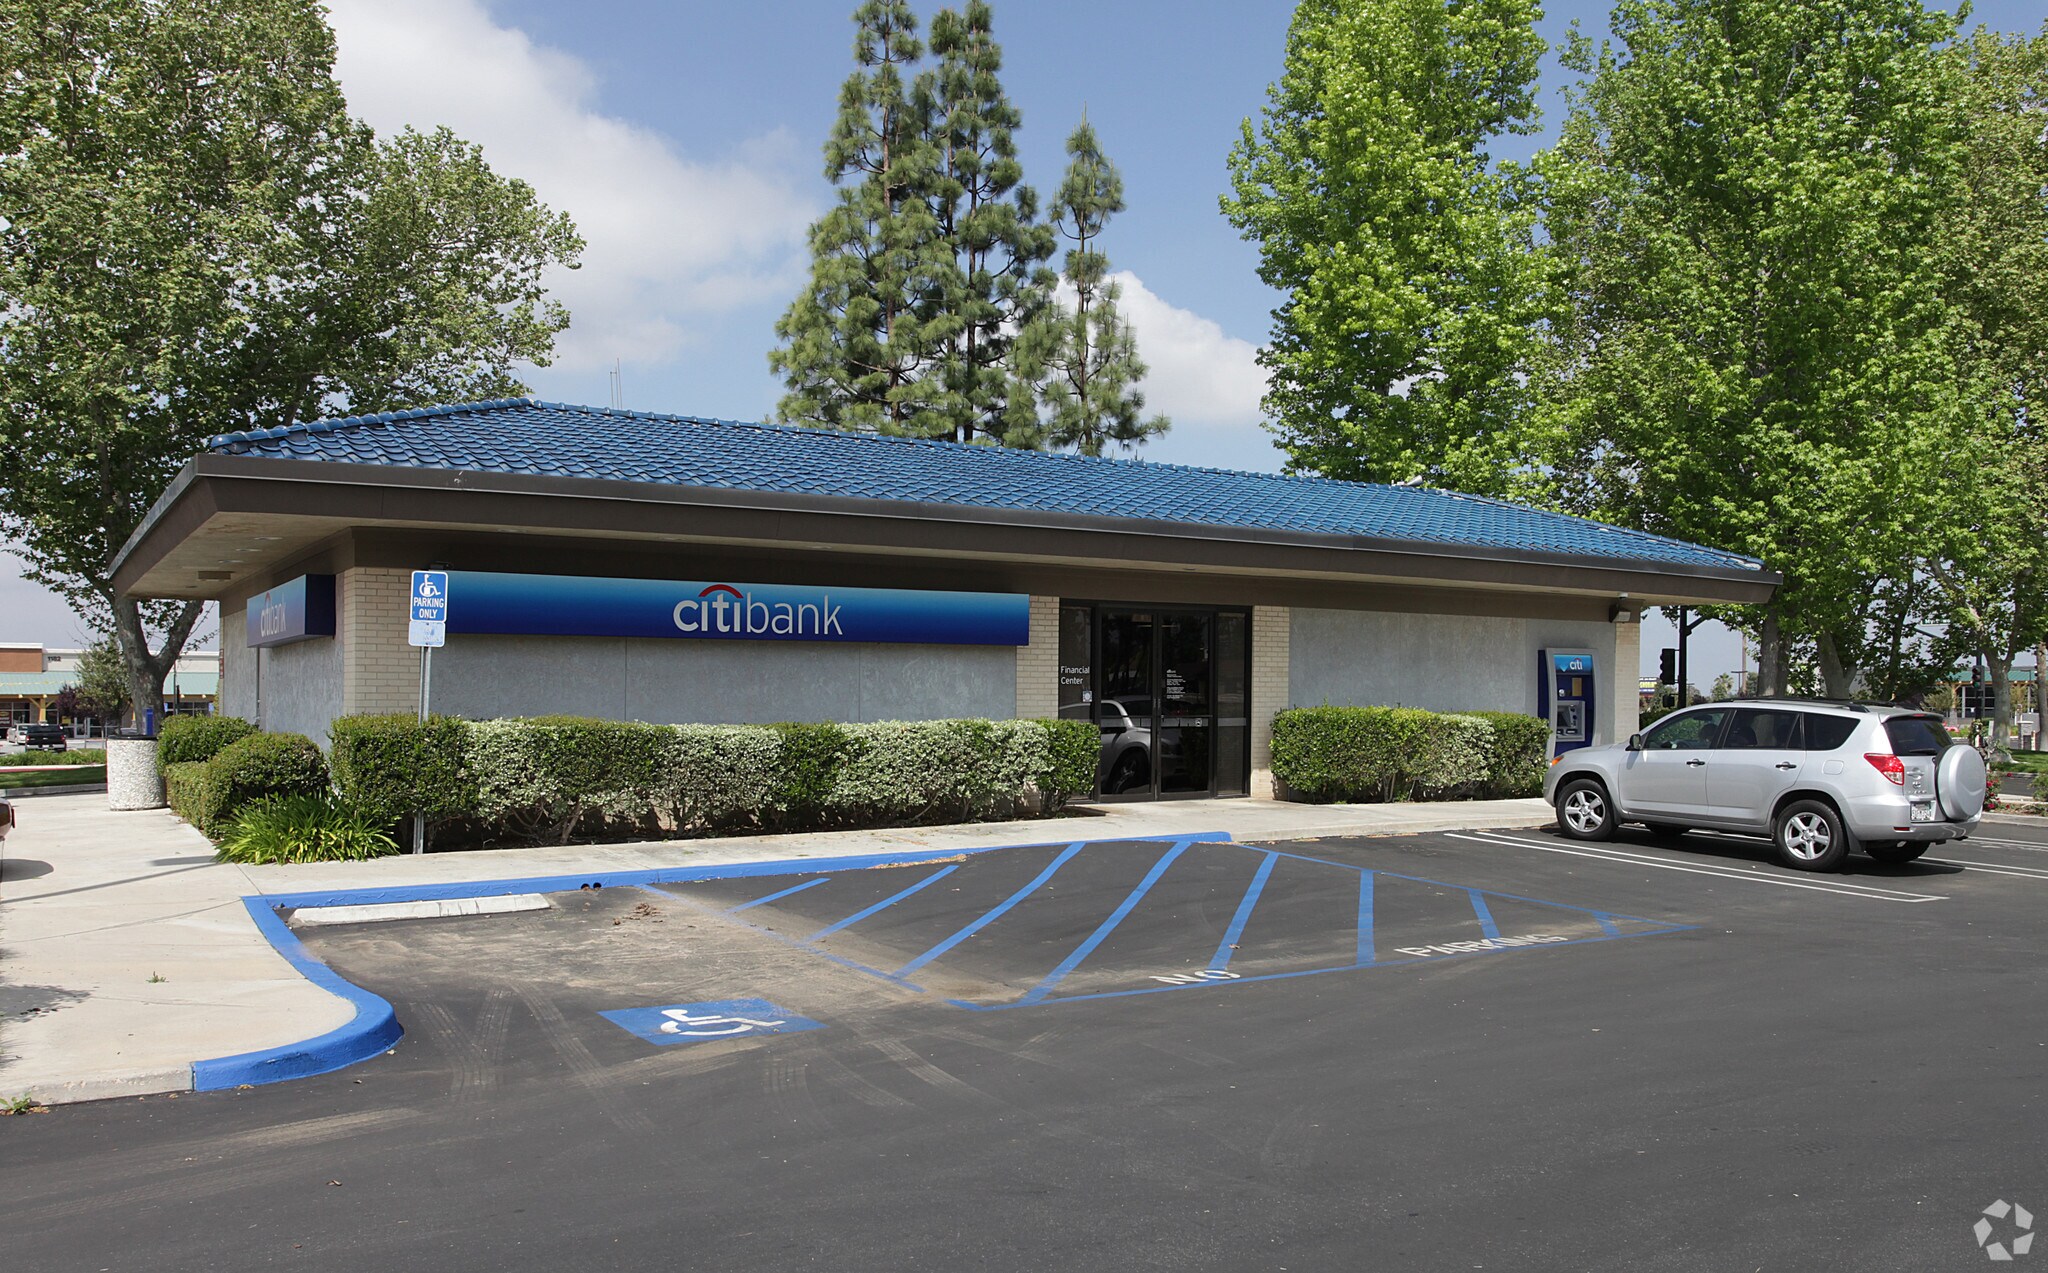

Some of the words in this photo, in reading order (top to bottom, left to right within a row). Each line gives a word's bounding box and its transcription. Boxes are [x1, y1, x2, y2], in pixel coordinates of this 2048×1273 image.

[413, 597, 444, 608] PARKING
[419, 608, 438, 619] ONLY
[673, 591, 843, 635] citibank
[1061, 666, 1090, 674] Financial
[1569, 659, 1583, 670] citi
[1061, 676, 1083, 685] Center
[1394, 934, 1569, 957] PARKING
[1148, 969, 1241, 985] NO
